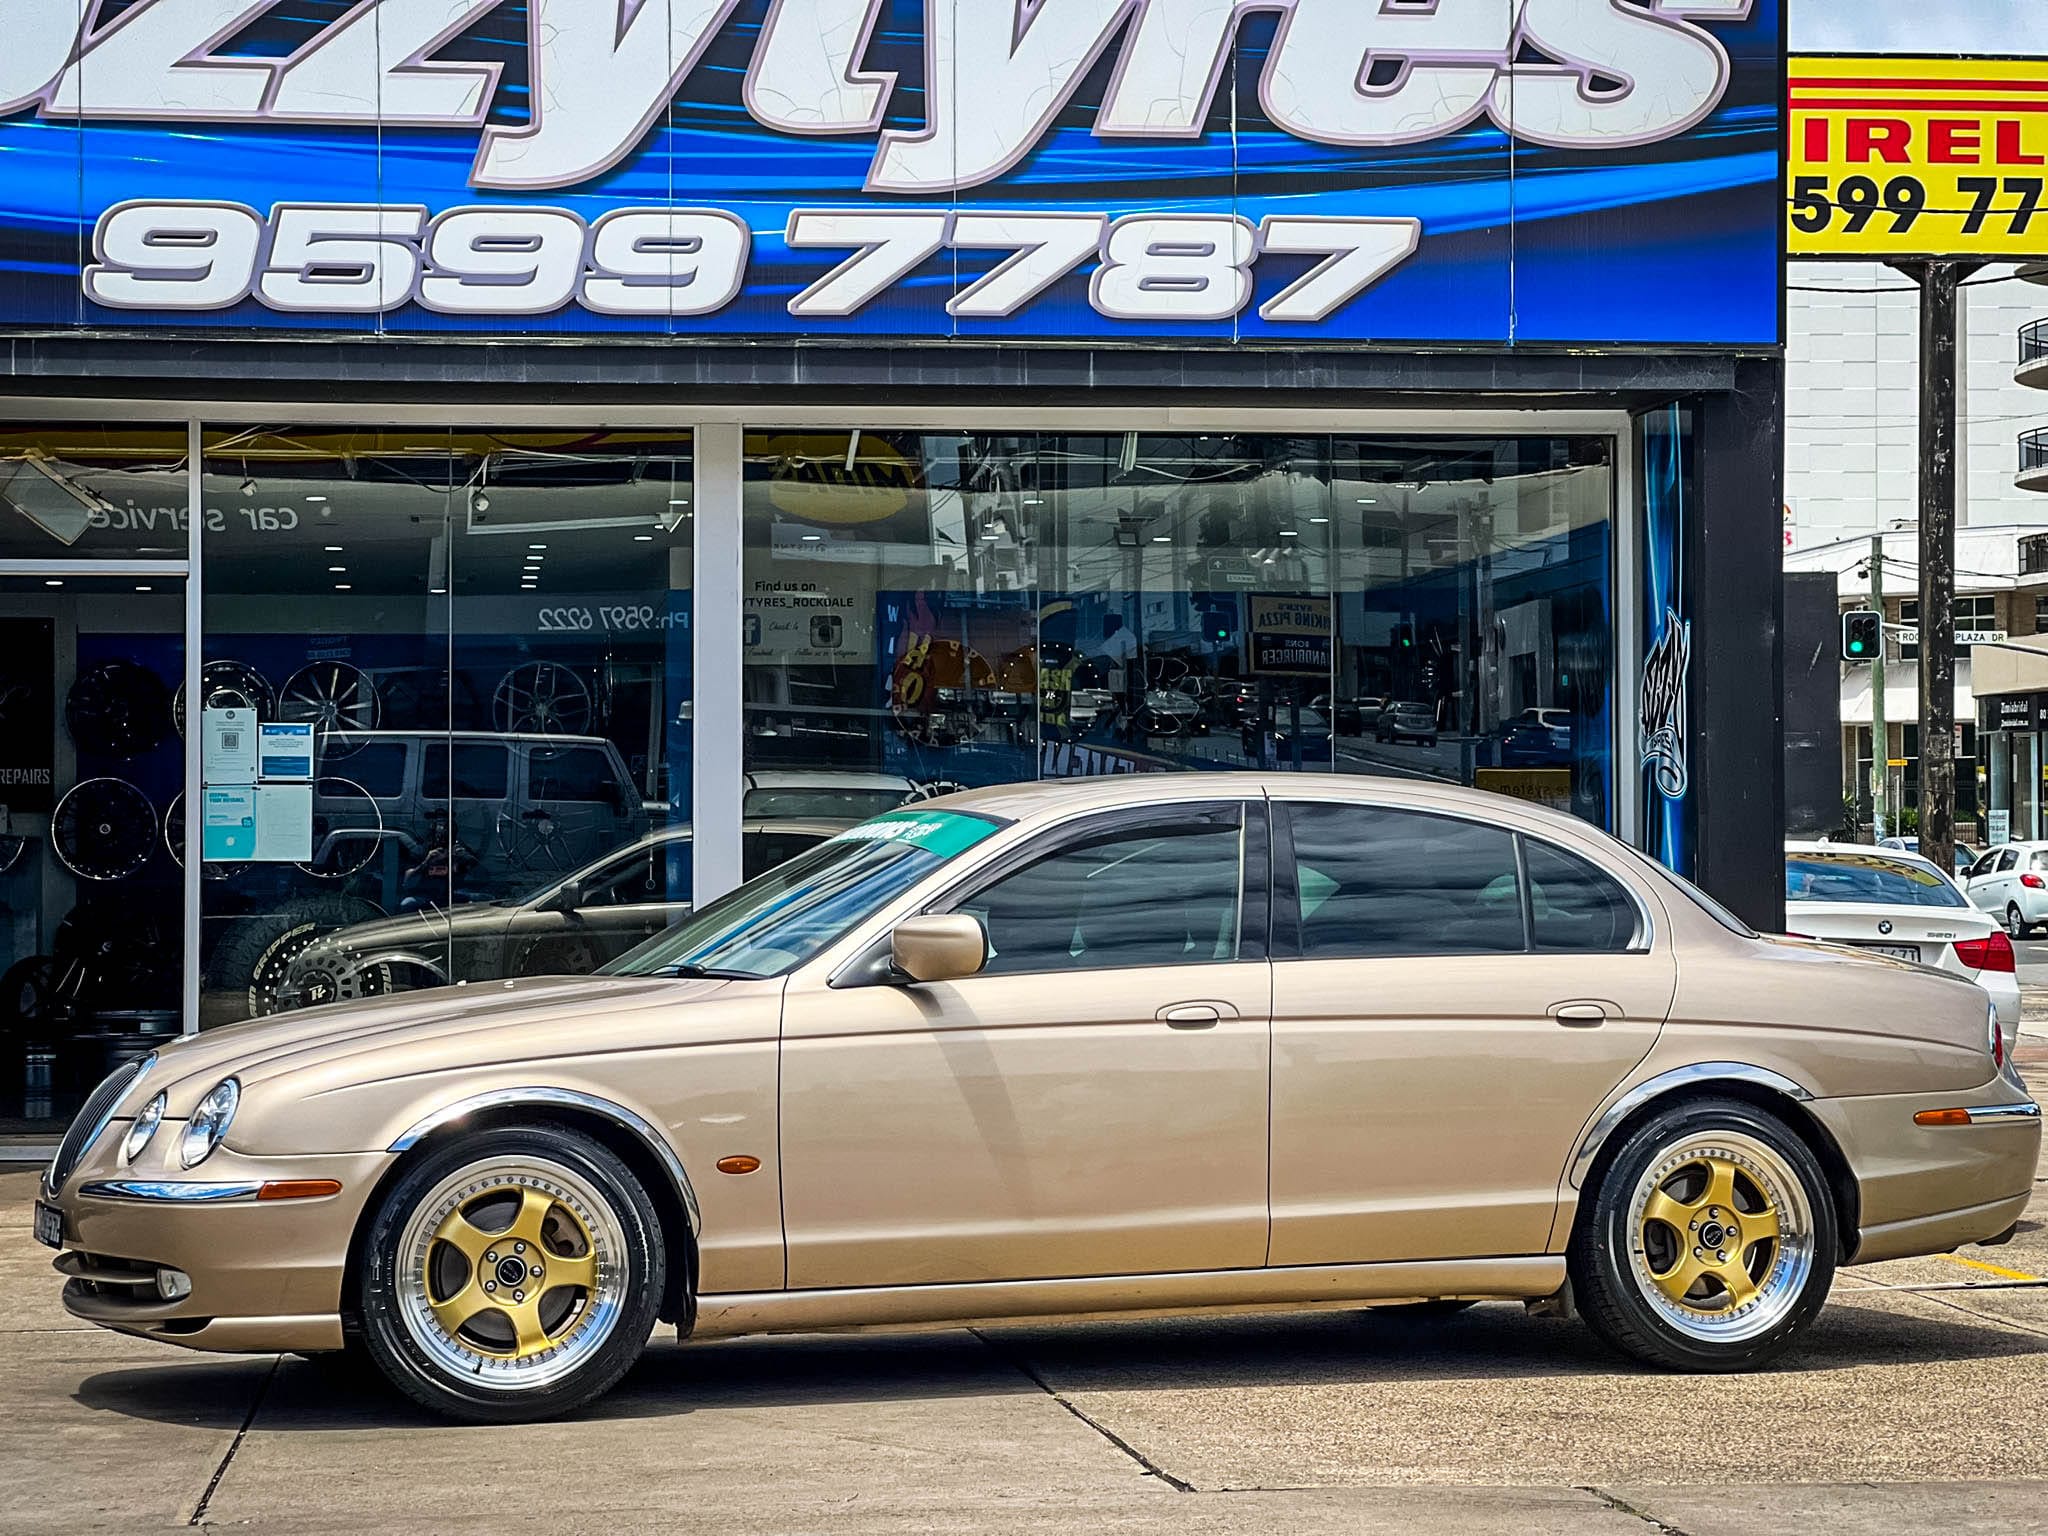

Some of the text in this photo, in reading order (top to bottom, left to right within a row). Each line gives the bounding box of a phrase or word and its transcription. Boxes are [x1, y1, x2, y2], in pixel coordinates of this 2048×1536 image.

[1803, 117, 2045, 165] IREL
[1790, 175, 2044, 235] 599 77
[83, 198, 1422, 322] 9599 7787
[755, 580, 817, 592] Find us on
[1955, 634, 1985, 642] PLAZA
[1991, 634, 2005, 642] DR
[0, 769, 50, 785] REPAIRS
[252, 922, 317, 981] GRIPPER
